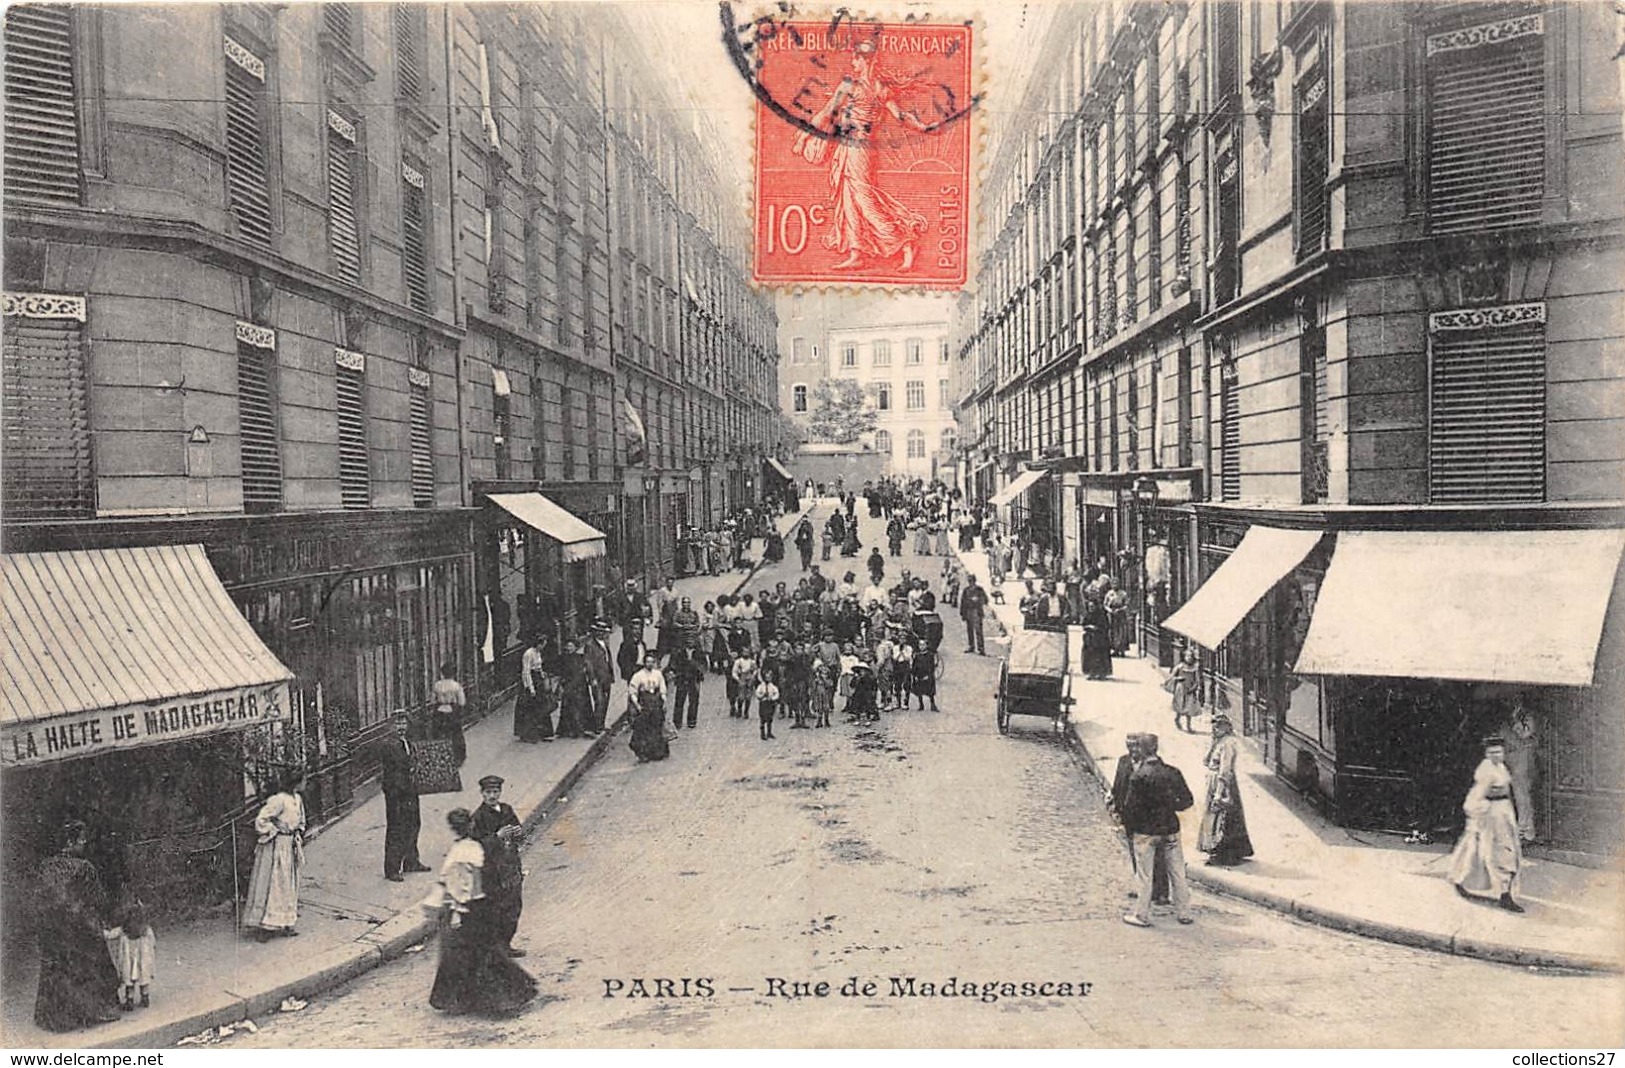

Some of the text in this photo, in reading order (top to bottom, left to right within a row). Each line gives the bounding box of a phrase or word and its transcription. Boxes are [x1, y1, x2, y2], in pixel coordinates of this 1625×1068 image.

[12, 693, 260, 760] LA HALTE DE MADAGASCAR
